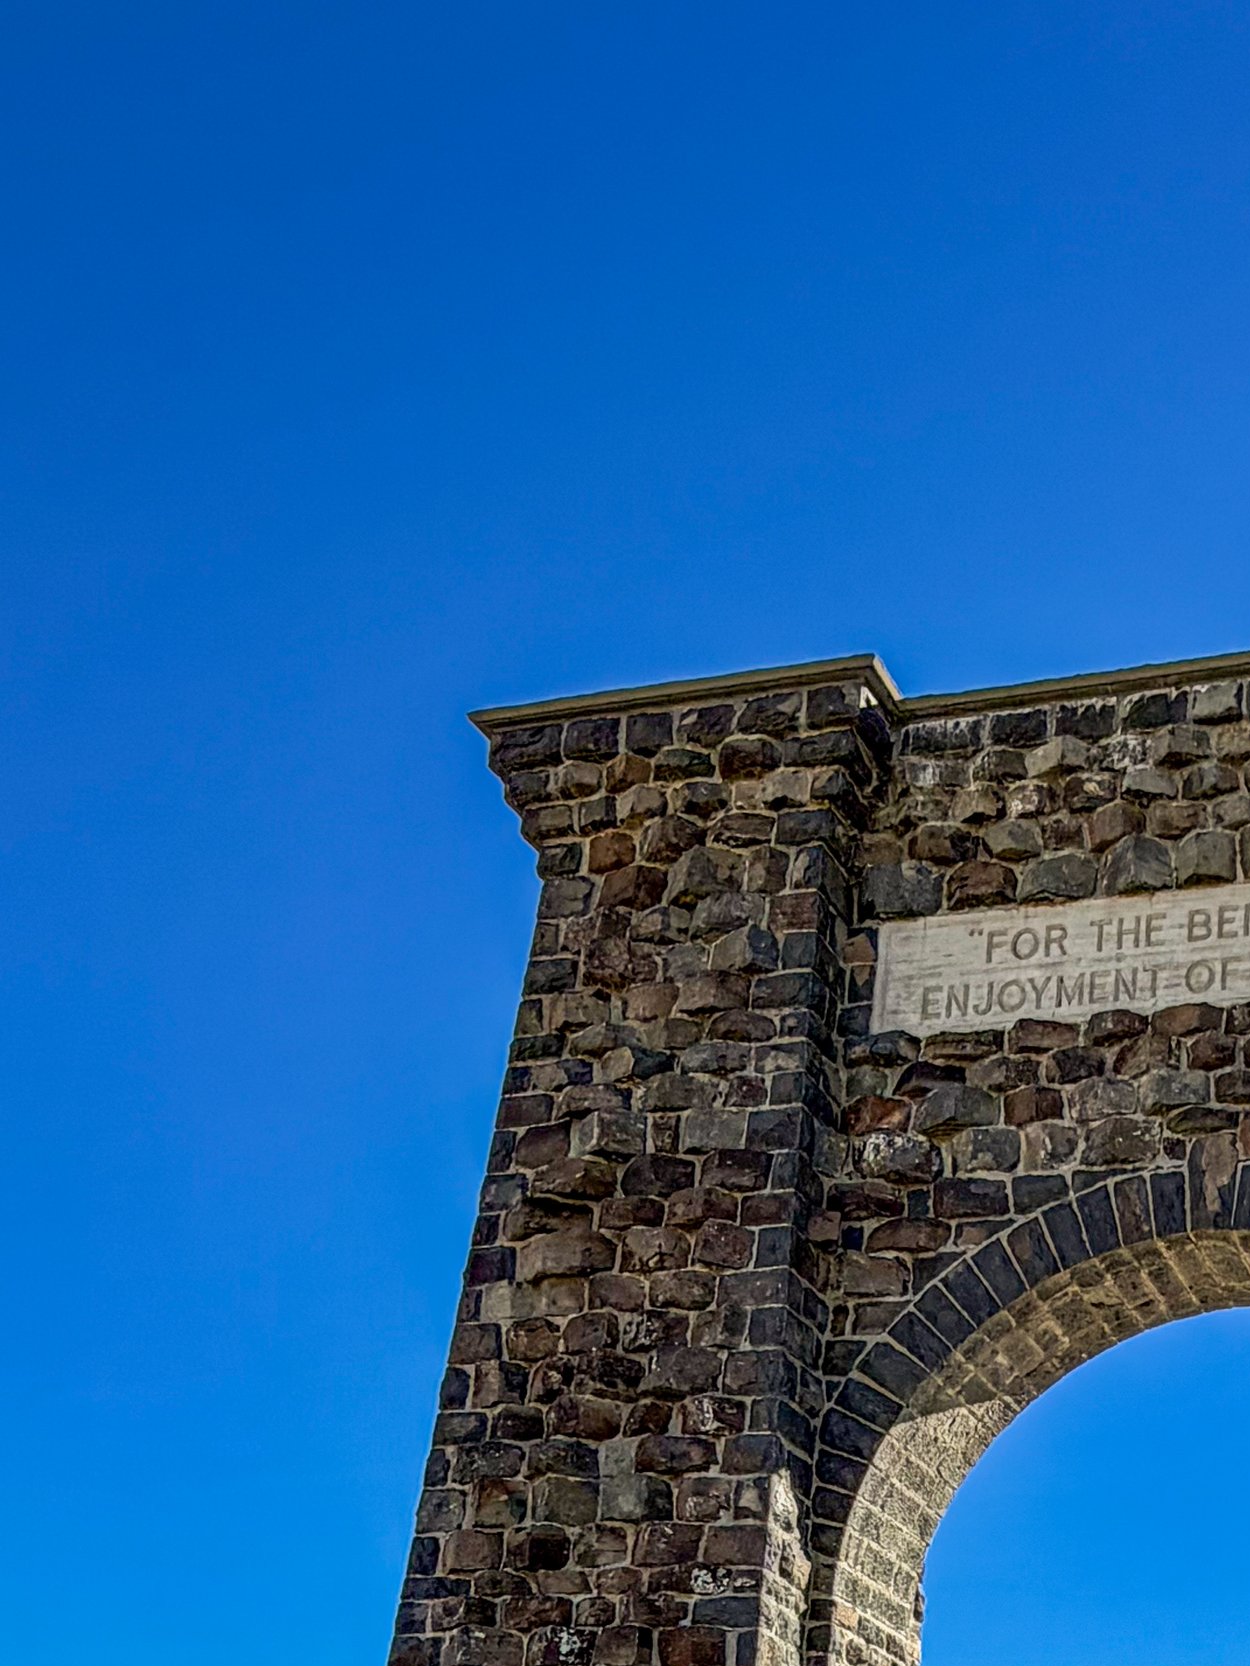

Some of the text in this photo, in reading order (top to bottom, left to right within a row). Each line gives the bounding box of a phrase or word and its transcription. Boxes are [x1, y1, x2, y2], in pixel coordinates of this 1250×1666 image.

[1090, 912, 1167, 952] THE
[920, 966, 1158, 1021] ENJOYMENT
[1185, 956, 1242, 994] OF
